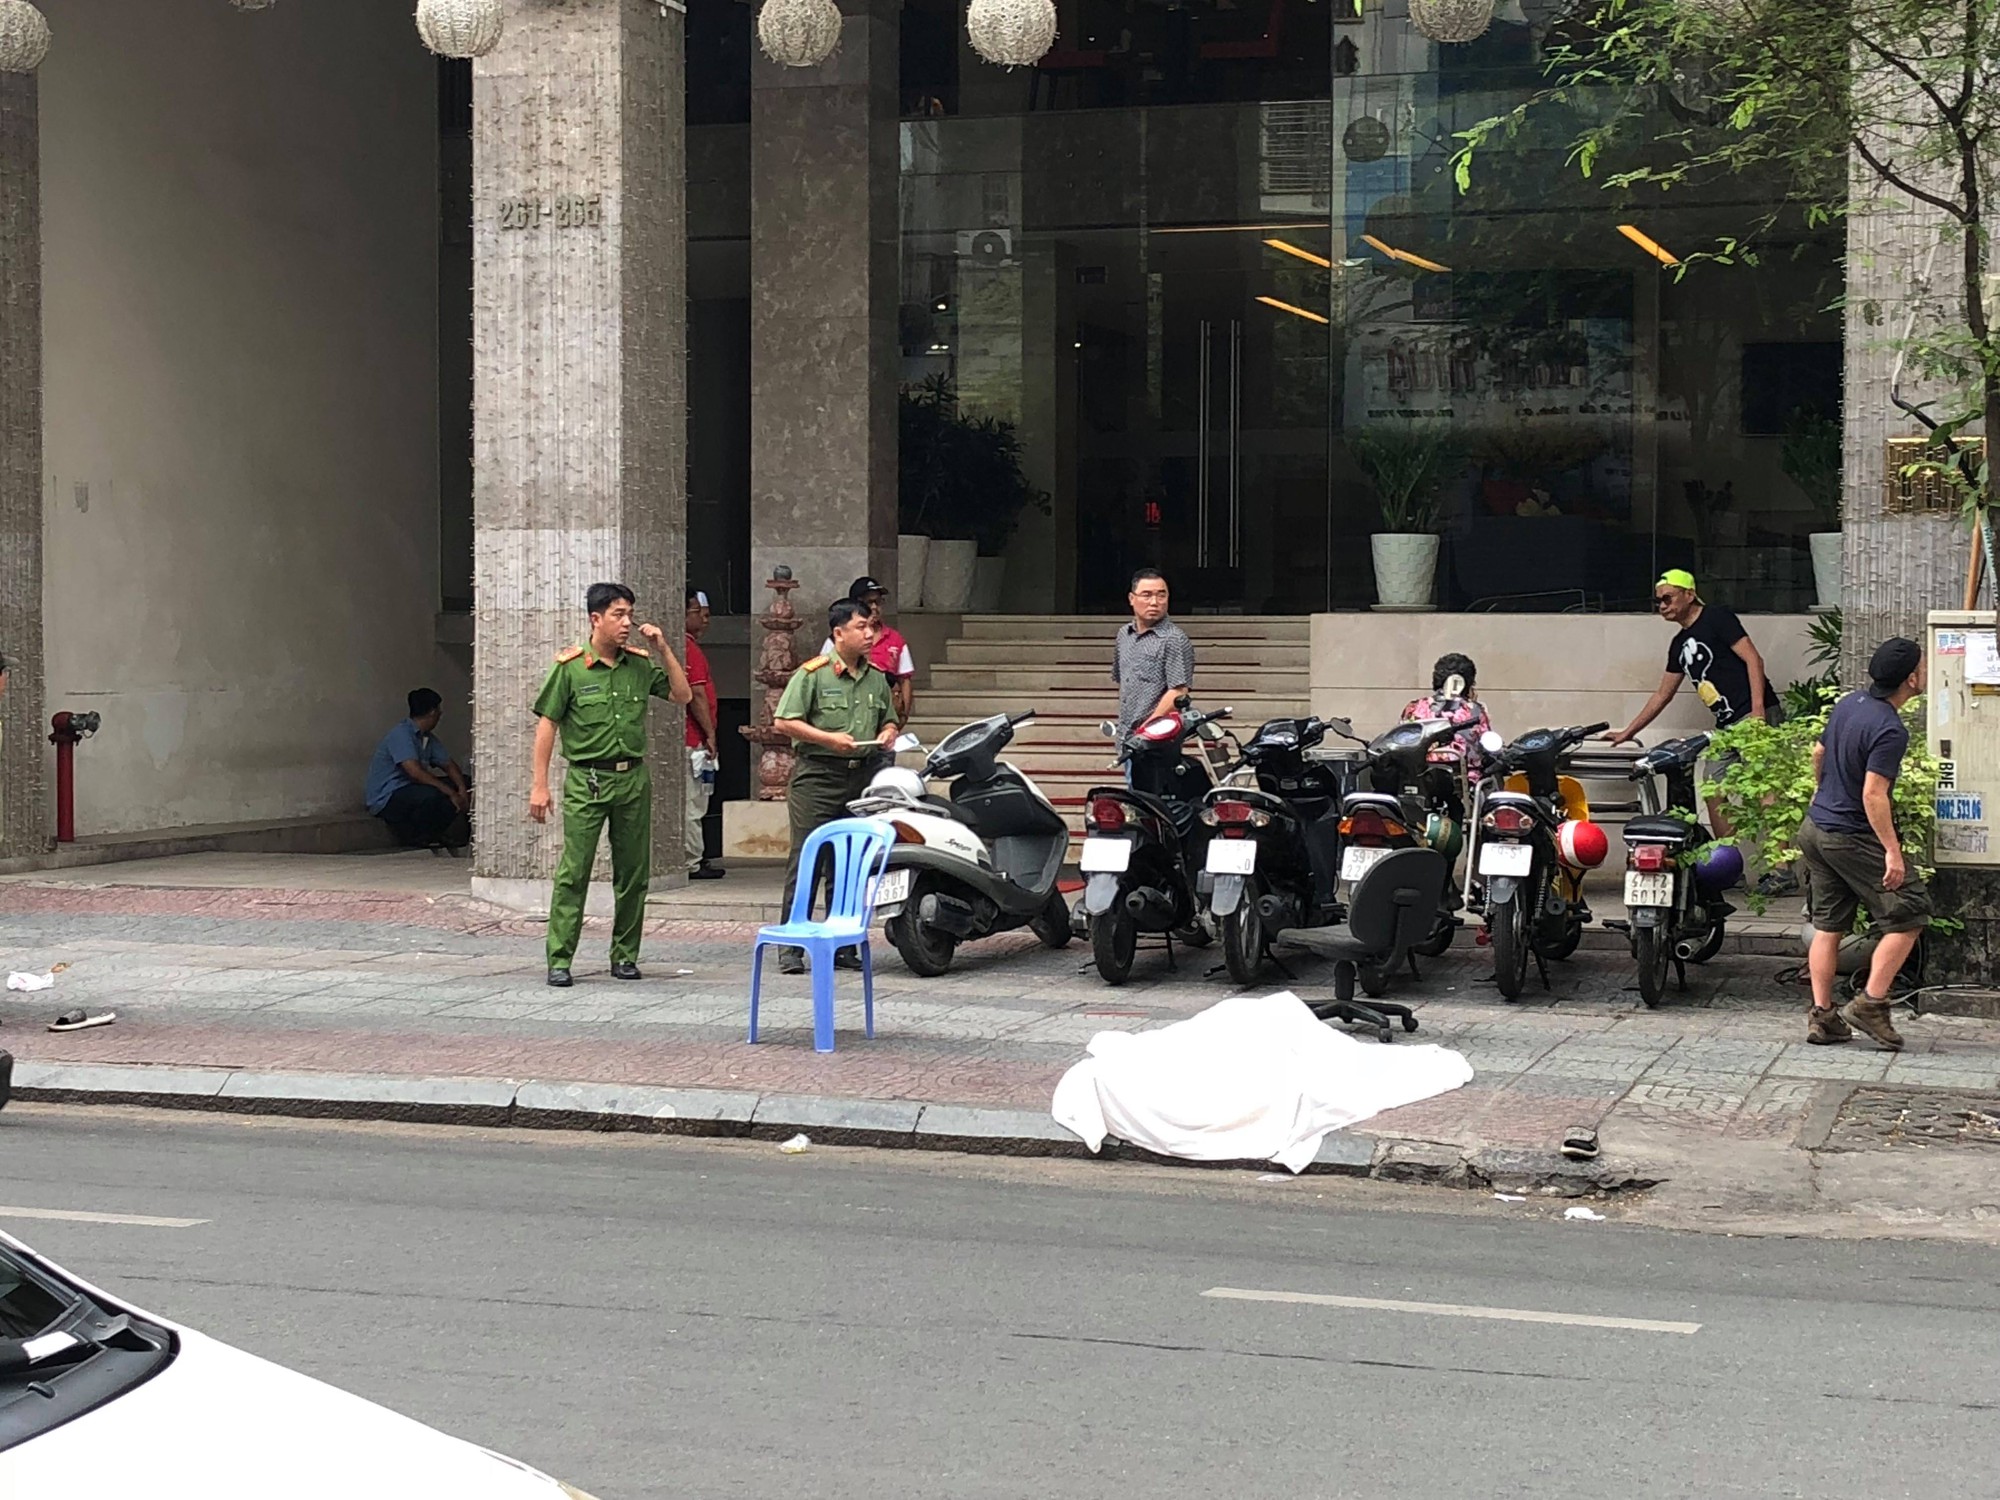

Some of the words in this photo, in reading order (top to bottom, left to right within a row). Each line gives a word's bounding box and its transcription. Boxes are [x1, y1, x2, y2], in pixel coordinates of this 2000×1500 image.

[500, 194, 601, 230] 261-265
[1938, 762, 1955, 789] BNE
[1631, 890, 1667, 905] 6012
